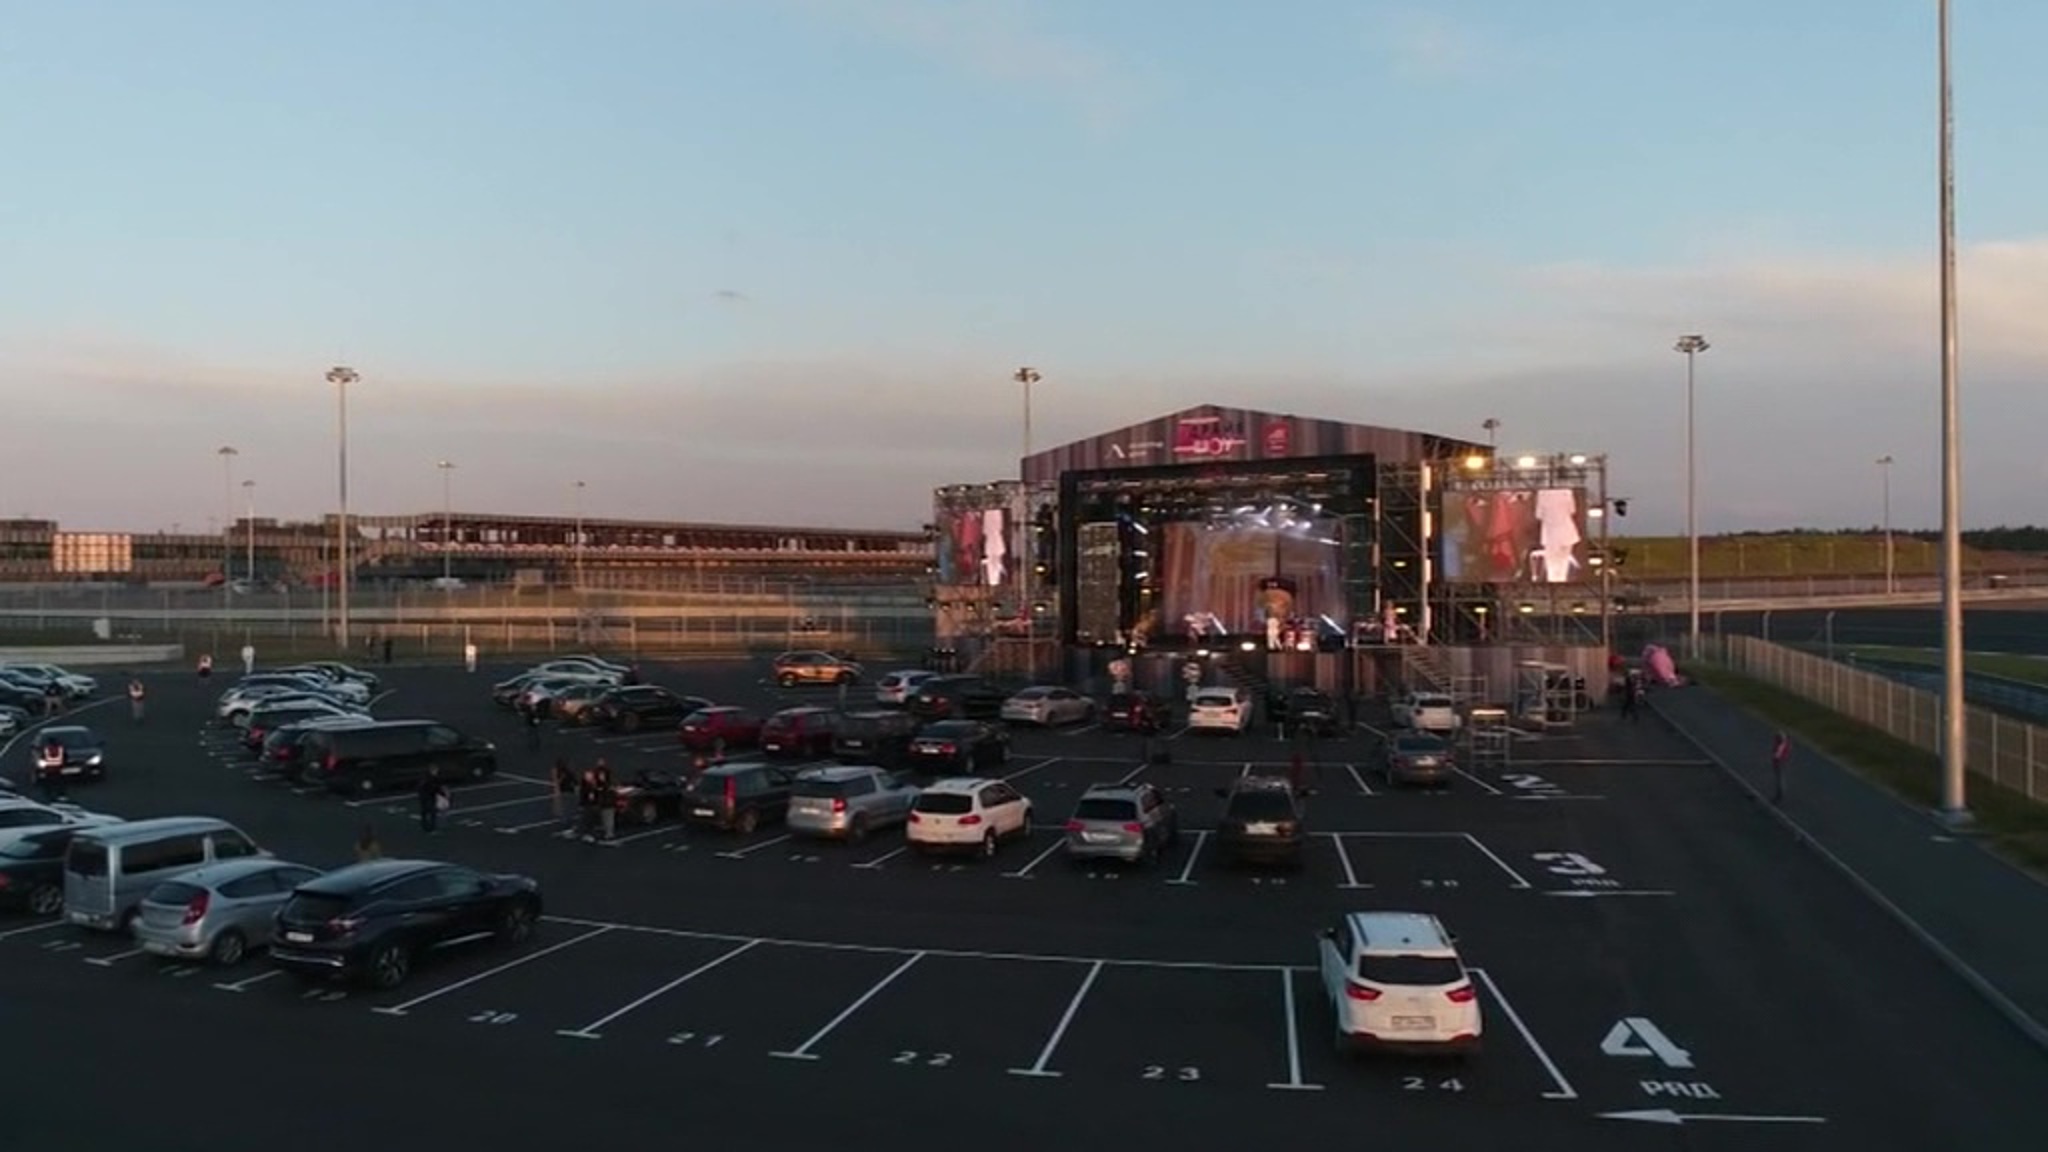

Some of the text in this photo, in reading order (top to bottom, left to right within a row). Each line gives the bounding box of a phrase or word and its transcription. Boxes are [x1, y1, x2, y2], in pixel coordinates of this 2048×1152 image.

[1532, 852, 1606, 874] 3
[467, 1010, 518, 1023] 20
[667, 1031, 723, 1047] 21
[1600, 1017, 1696, 1068] 4
[892, 1051, 953, 1066] 22
[1142, 1065, 1200, 1081] 23
[1402, 1076, 1465, 1092] 24
